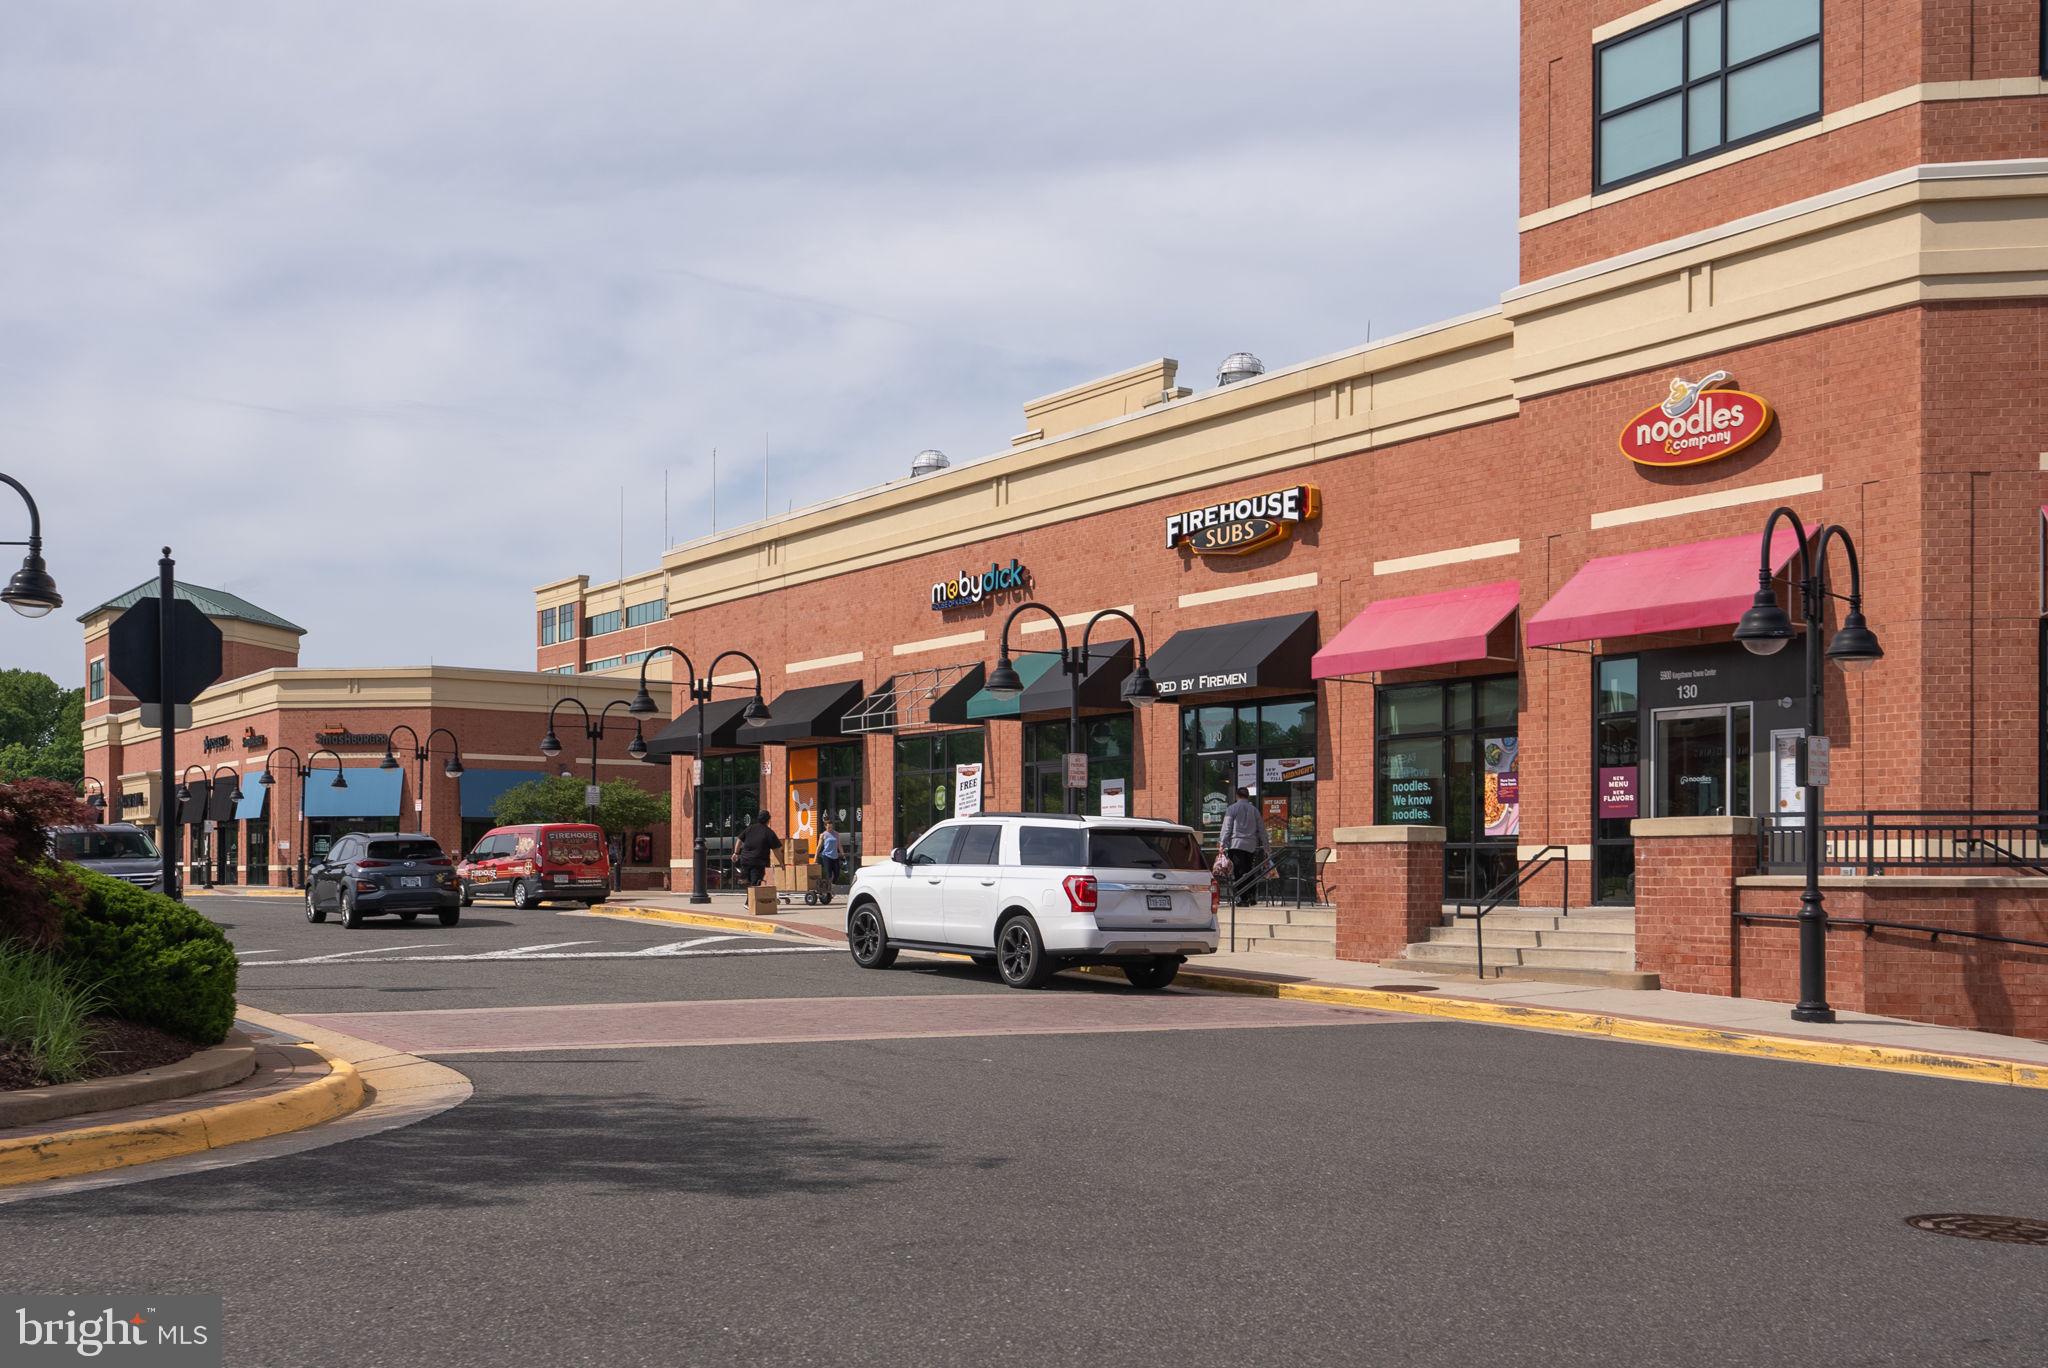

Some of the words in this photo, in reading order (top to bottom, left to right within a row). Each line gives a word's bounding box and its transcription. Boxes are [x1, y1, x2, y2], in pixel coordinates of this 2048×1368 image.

[1636, 396, 1744, 446] noodles
[1672, 430, 1731, 450] company
[1166, 487, 1300, 549] FIREHOUSE
[1206, 521, 1254, 548] SUBS
[1181, 678, 1195, 691] BY
[1199, 672, 1247, 689] FIREMEN
[1677, 684, 1698, 699] 130
[960, 778, 978, 791] FREE
[1392, 780, 1431, 792] noodles.
[1392, 794, 1407, 806] We
[1407, 794, 1433, 806] know
[1392, 808, 1431, 820] noodles.
[548, 832, 599, 840] FIREHOUSE
